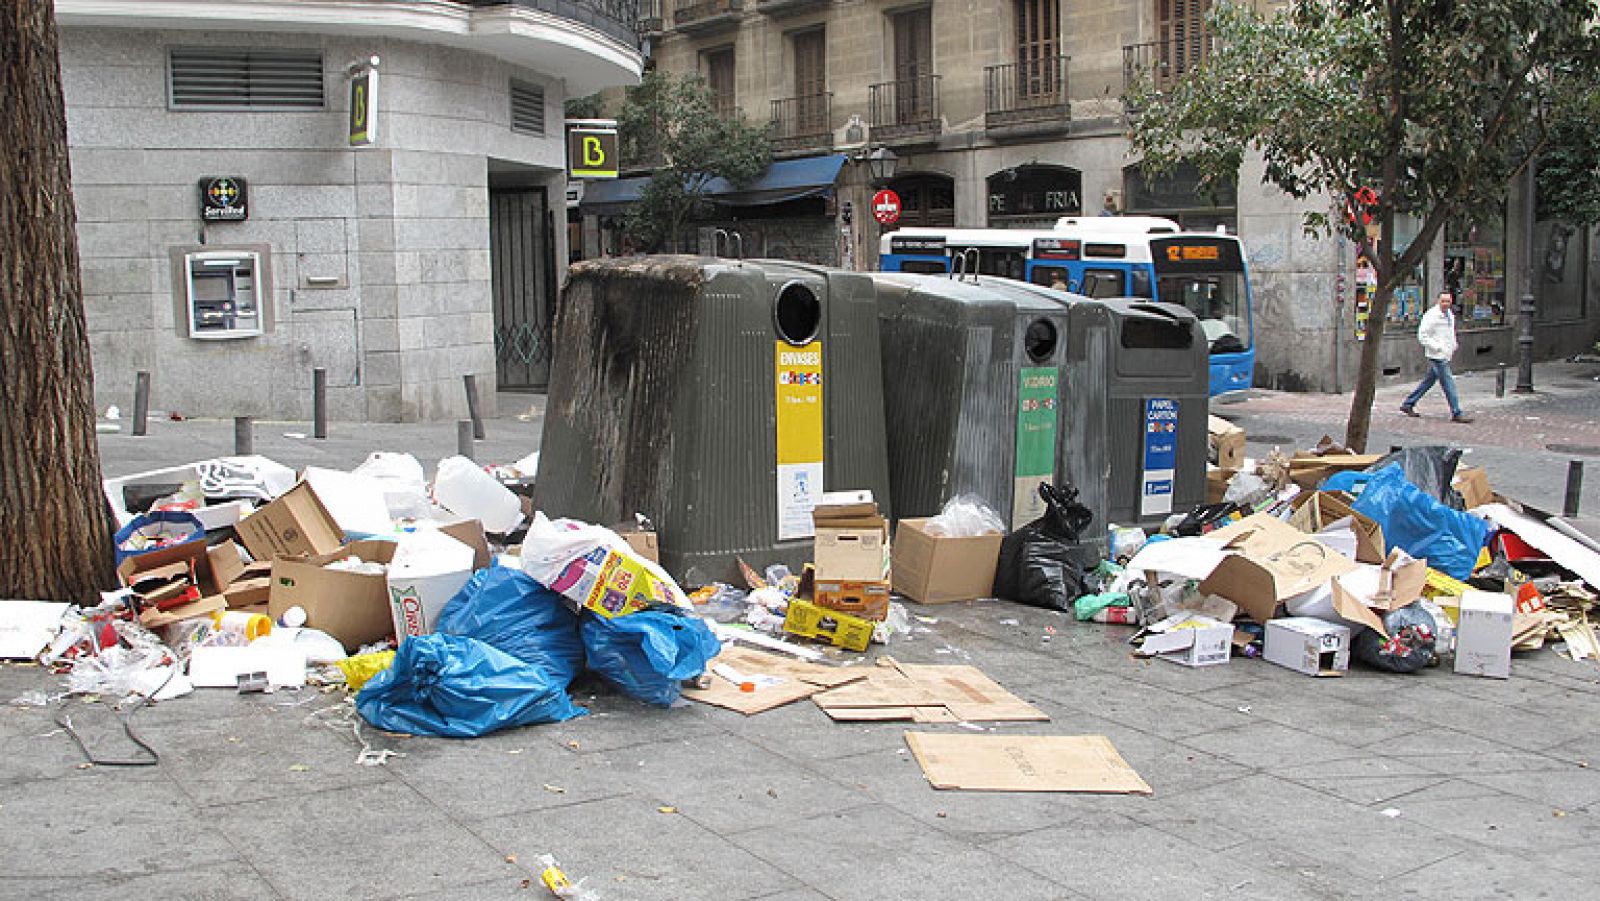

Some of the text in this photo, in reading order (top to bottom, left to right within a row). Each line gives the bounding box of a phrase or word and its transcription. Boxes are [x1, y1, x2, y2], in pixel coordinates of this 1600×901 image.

[354, 85, 366, 128] B
[583, 136, 605, 166] B
[780, 351, 819, 366] ENVASES
